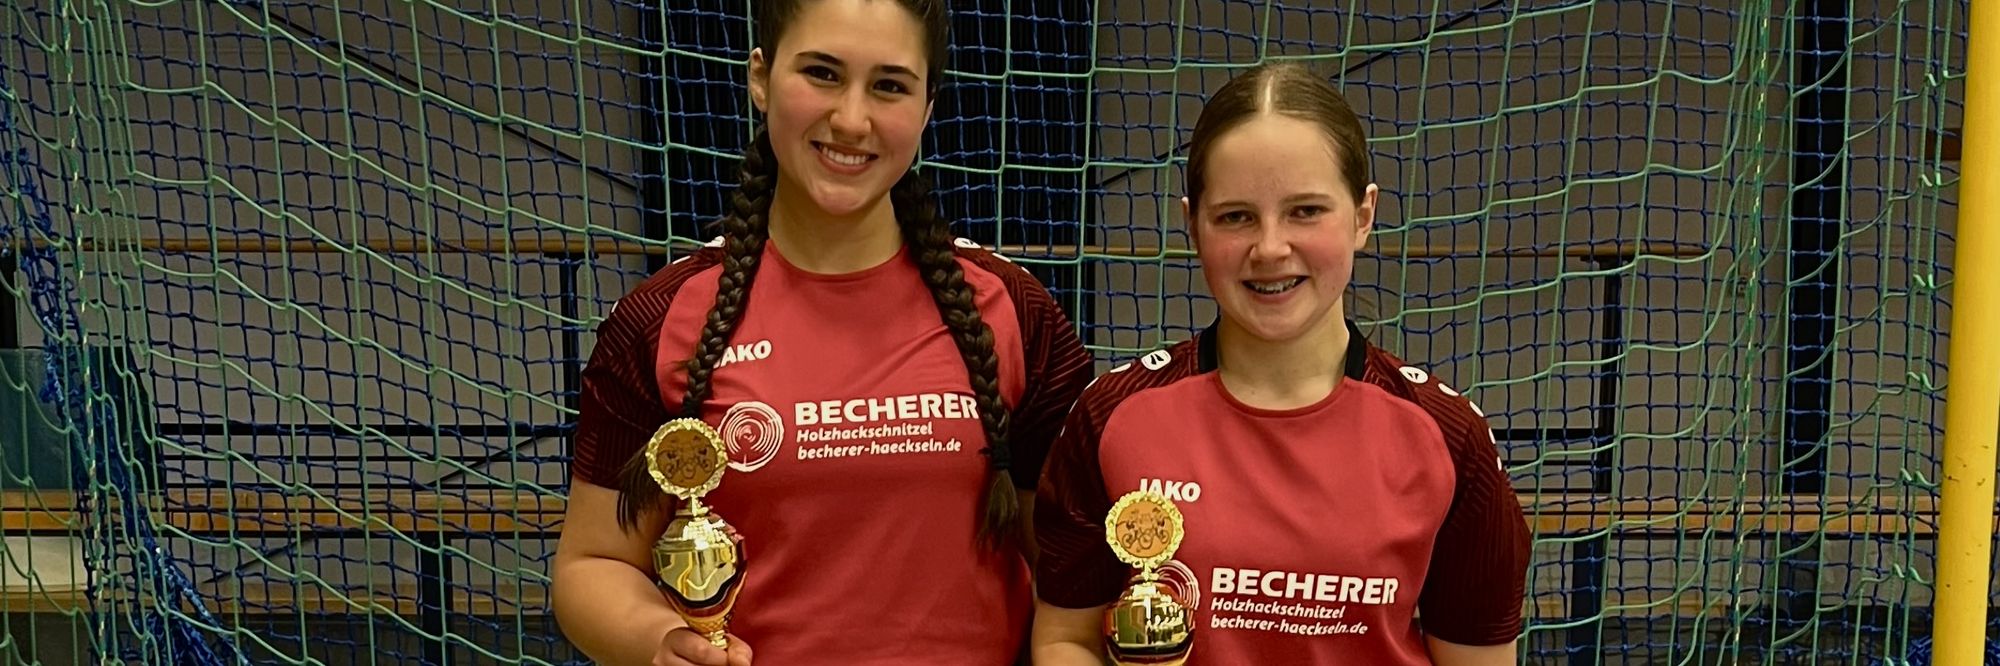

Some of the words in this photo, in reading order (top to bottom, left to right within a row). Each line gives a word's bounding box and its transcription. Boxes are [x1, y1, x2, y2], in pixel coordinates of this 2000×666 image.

[795, 392, 979, 426] BECHERER
[796, 421, 933, 443] Holzhackschnitzel
[797, 438, 962, 460] becherer-haeckseln.de
[1140, 478, 1201, 503] JAKO
[1211, 567, 1399, 605] BECHERER
[1210, 597, 1346, 619] Holzhackschnitzel
[1210, 614, 1368, 636] becherer-haeckseln.de
